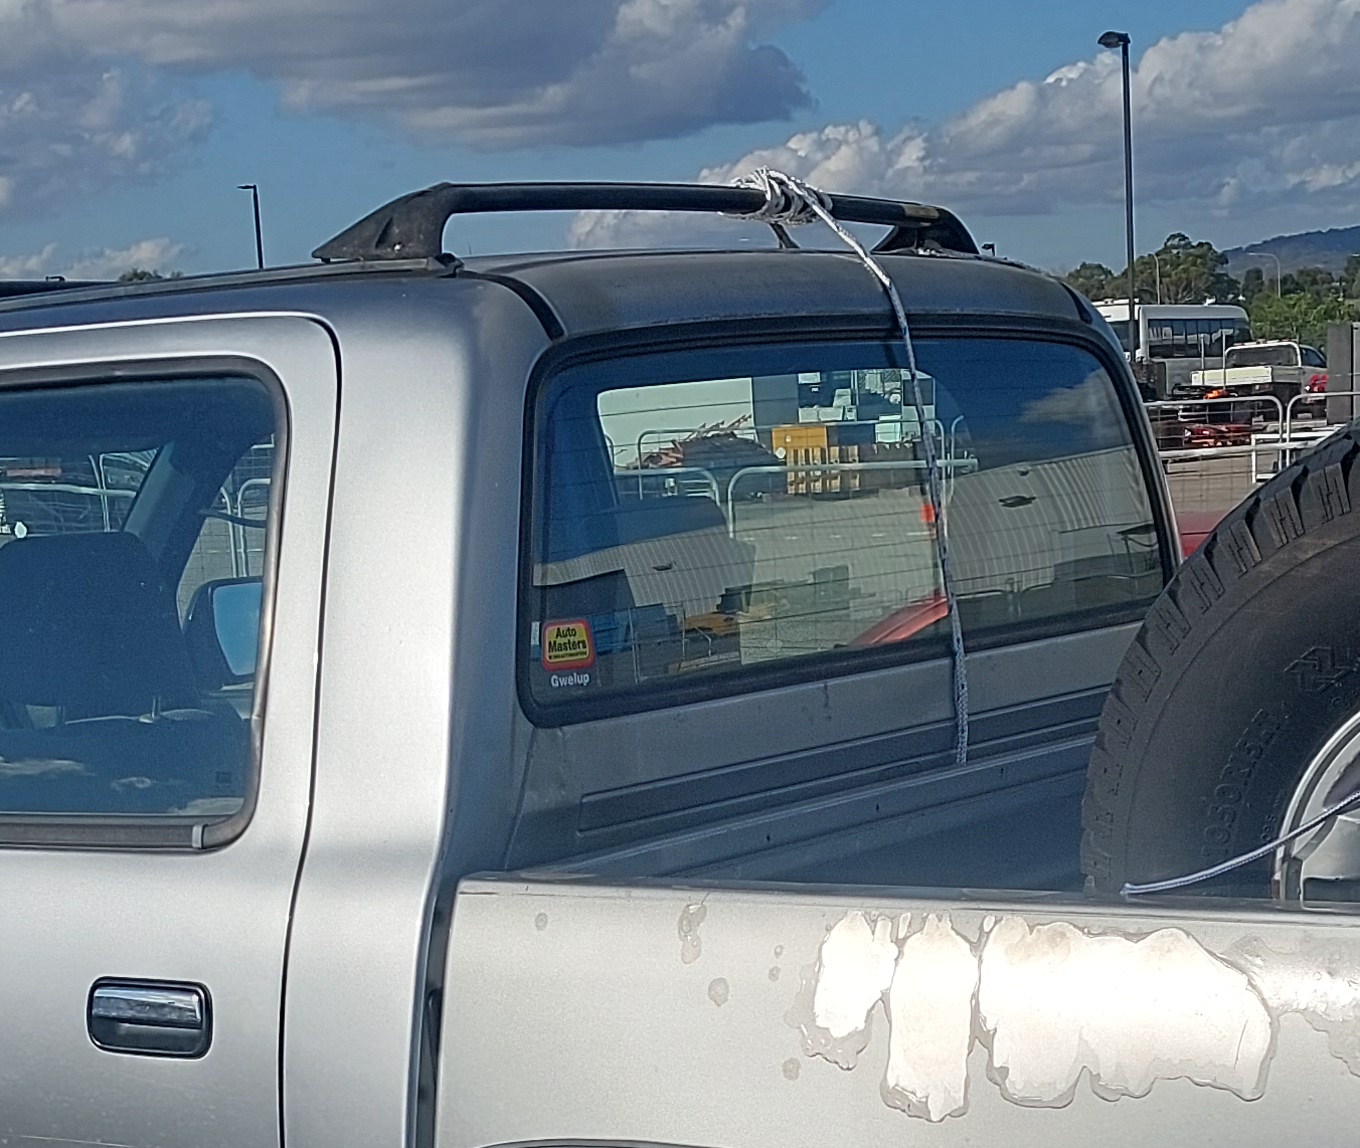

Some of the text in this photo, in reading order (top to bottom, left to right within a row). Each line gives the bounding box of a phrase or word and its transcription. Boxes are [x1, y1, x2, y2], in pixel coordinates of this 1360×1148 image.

[555, 626, 577, 639] Auto
[548, 639, 587, 653] Masters
[550, 672, 590, 687] Gwelup
